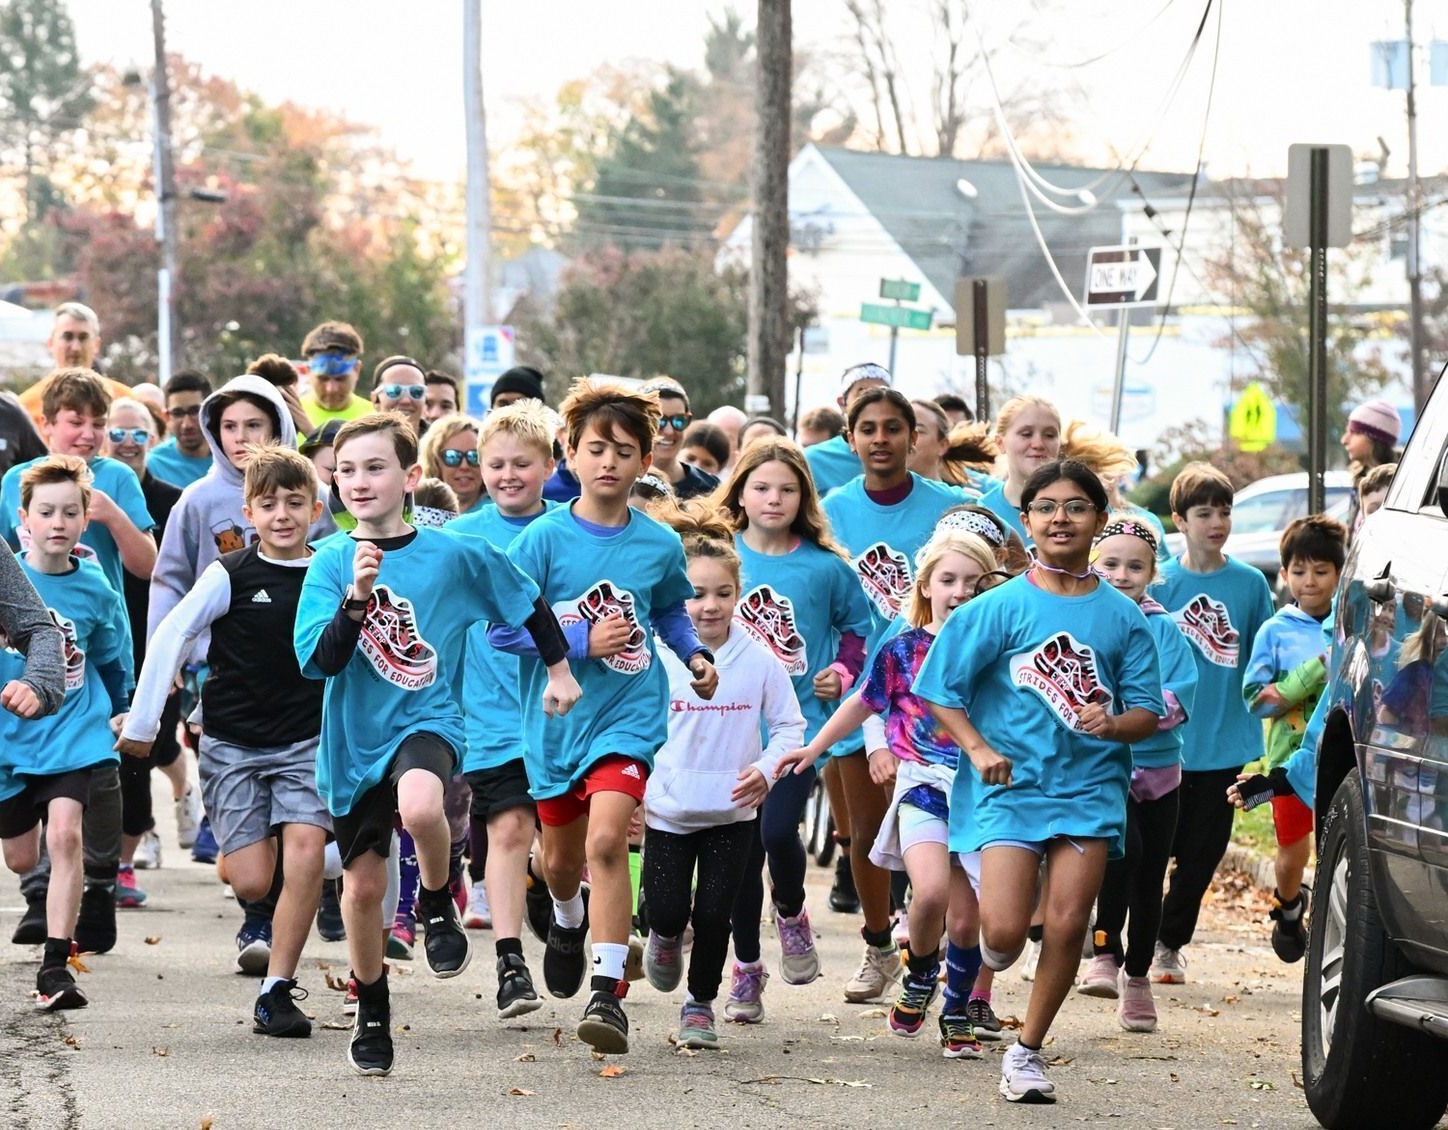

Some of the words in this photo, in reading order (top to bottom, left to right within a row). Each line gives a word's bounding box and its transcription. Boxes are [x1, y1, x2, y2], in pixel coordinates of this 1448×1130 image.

[1094, 267, 1114, 288] ONE
[1119, 266, 1138, 287] WAY
[373, 654, 389, 675] FOR
[669, 699, 752, 717] Champion
[1018, 672, 1058, 703] STRIDES
[1058, 702, 1073, 724] FOR
